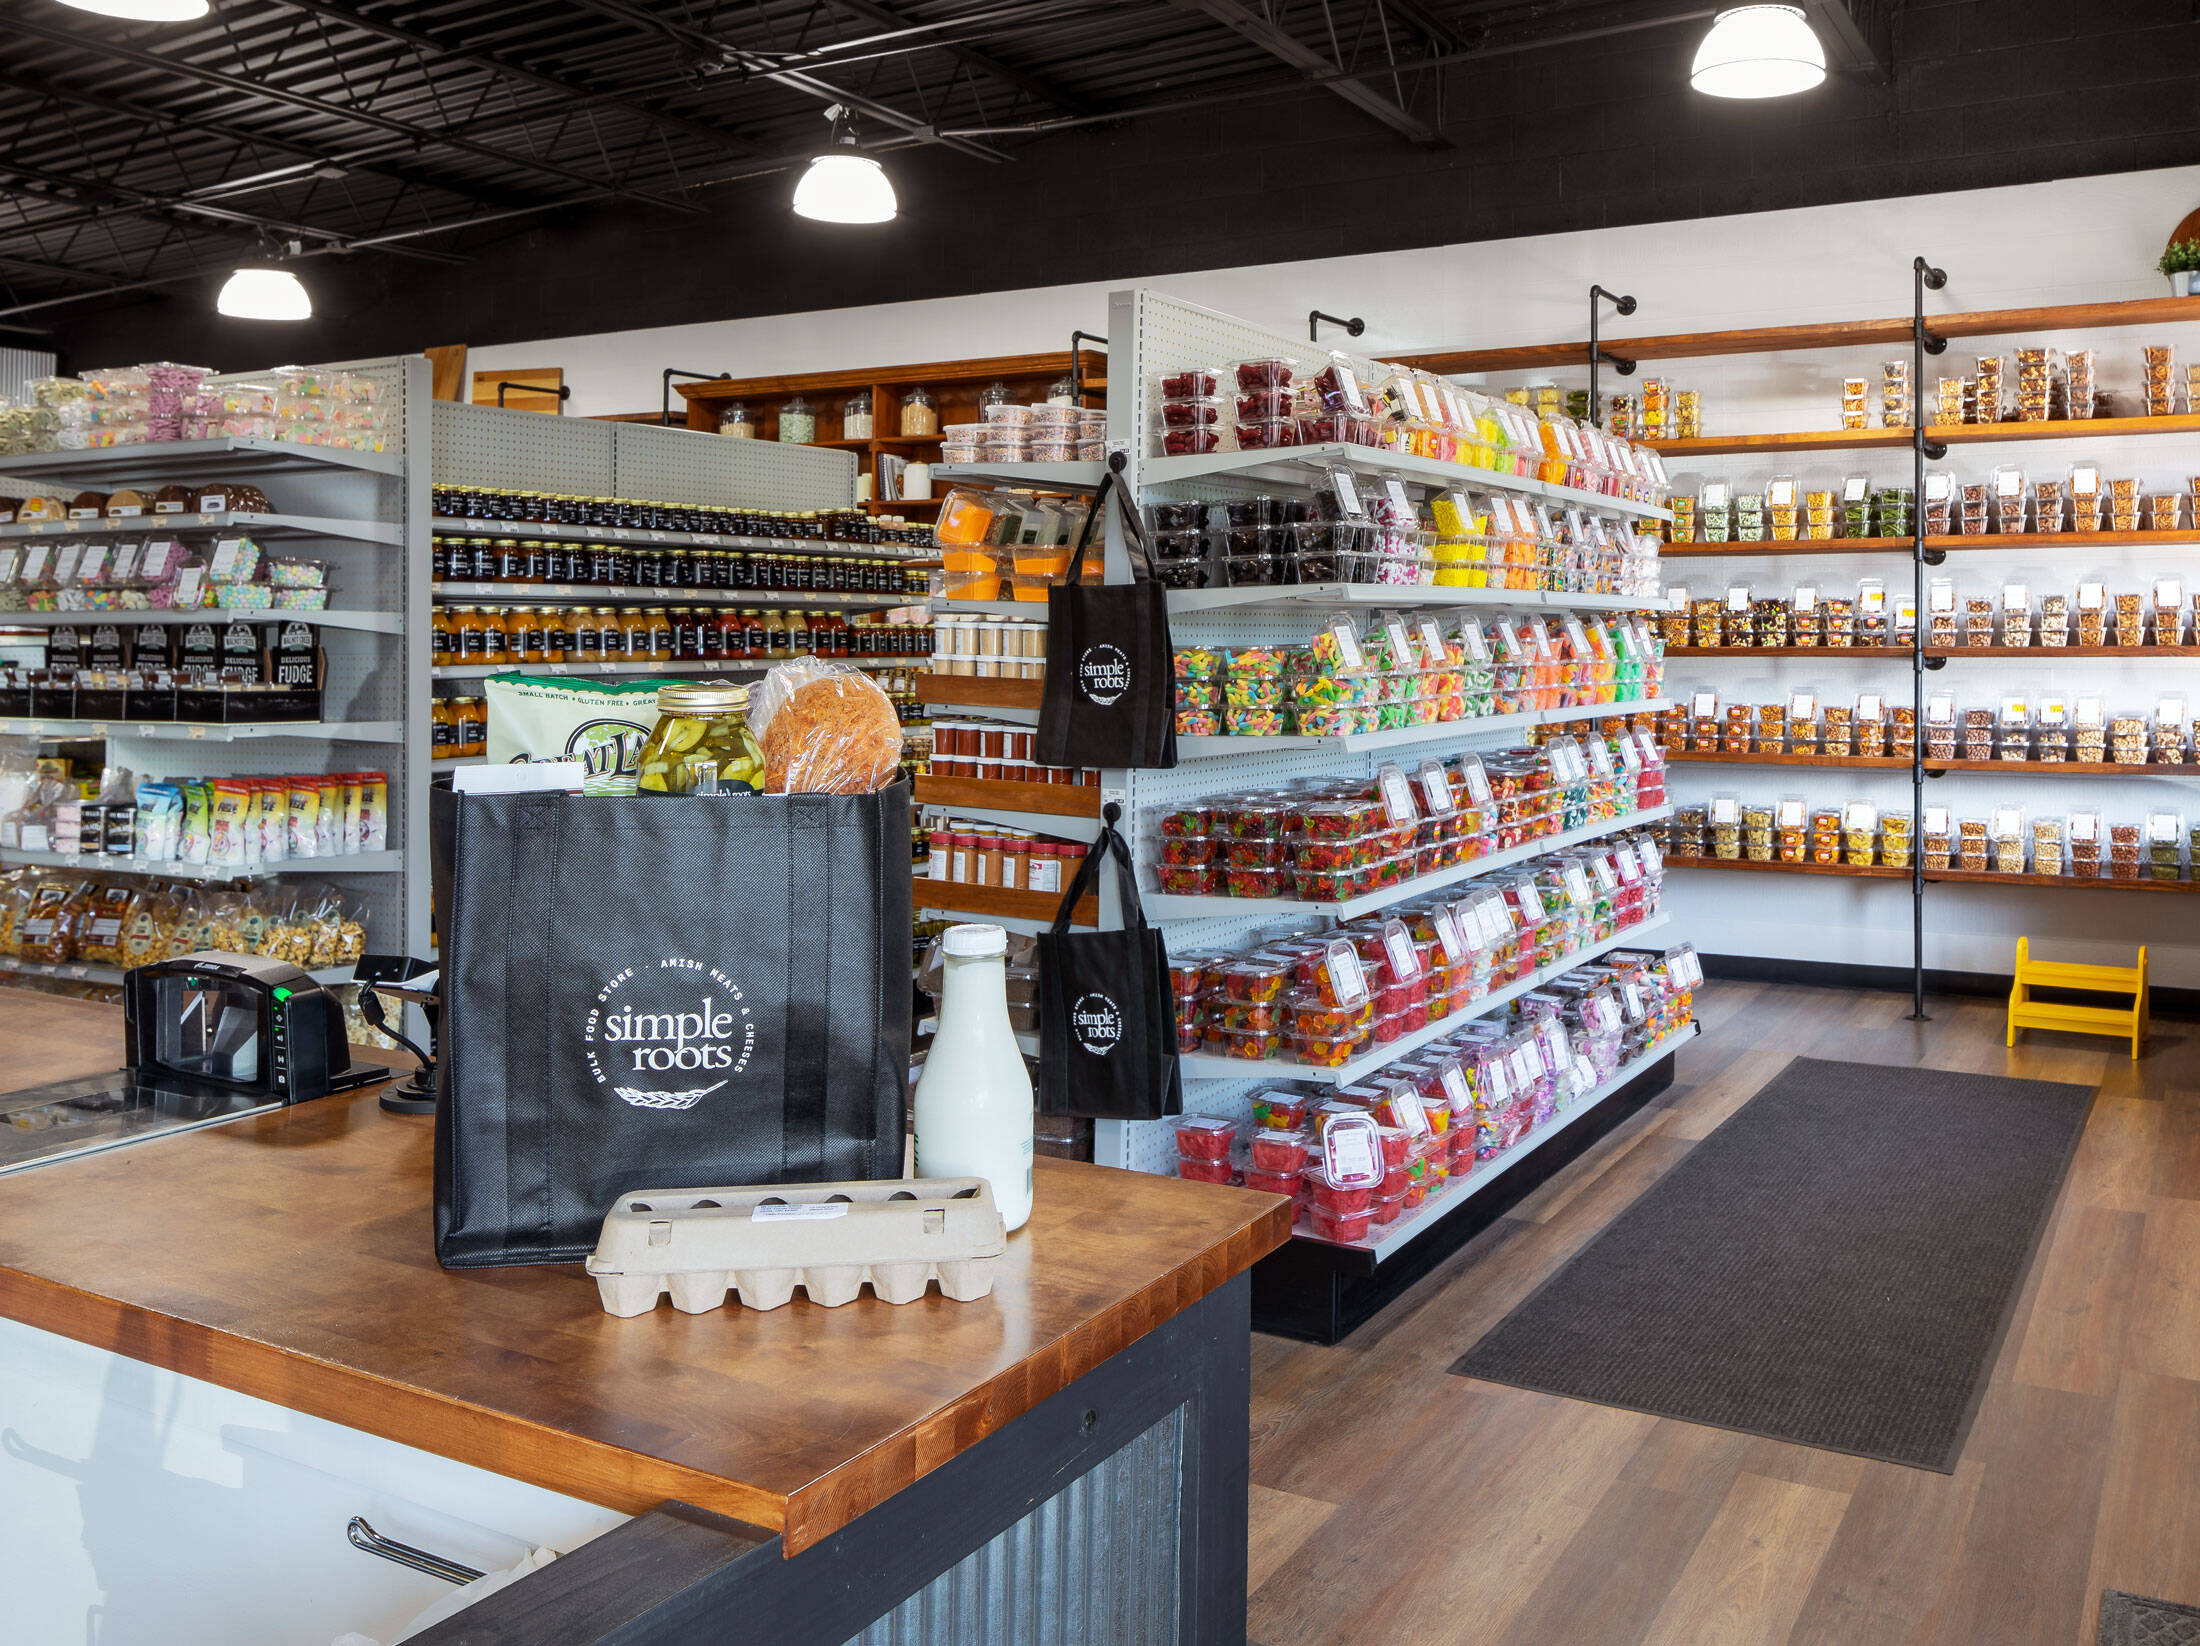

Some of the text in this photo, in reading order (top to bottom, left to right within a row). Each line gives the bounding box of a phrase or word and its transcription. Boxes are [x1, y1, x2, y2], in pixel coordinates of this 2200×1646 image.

[278, 664, 313, 684] FUDGE
[1084, 658, 1124, 679] simple
[1094, 676, 1124, 689] roots
[577, 697, 605, 706] GLUTEN
[585, 958, 755, 1083] BULK FOOD STORE AMISH MEATS & CHEESES
[604, 997, 733, 1054] simple
[1077, 1007, 1115, 1028] simple
[1087, 1025, 1116, 1038] roots
[632, 1043, 733, 1071] roots
